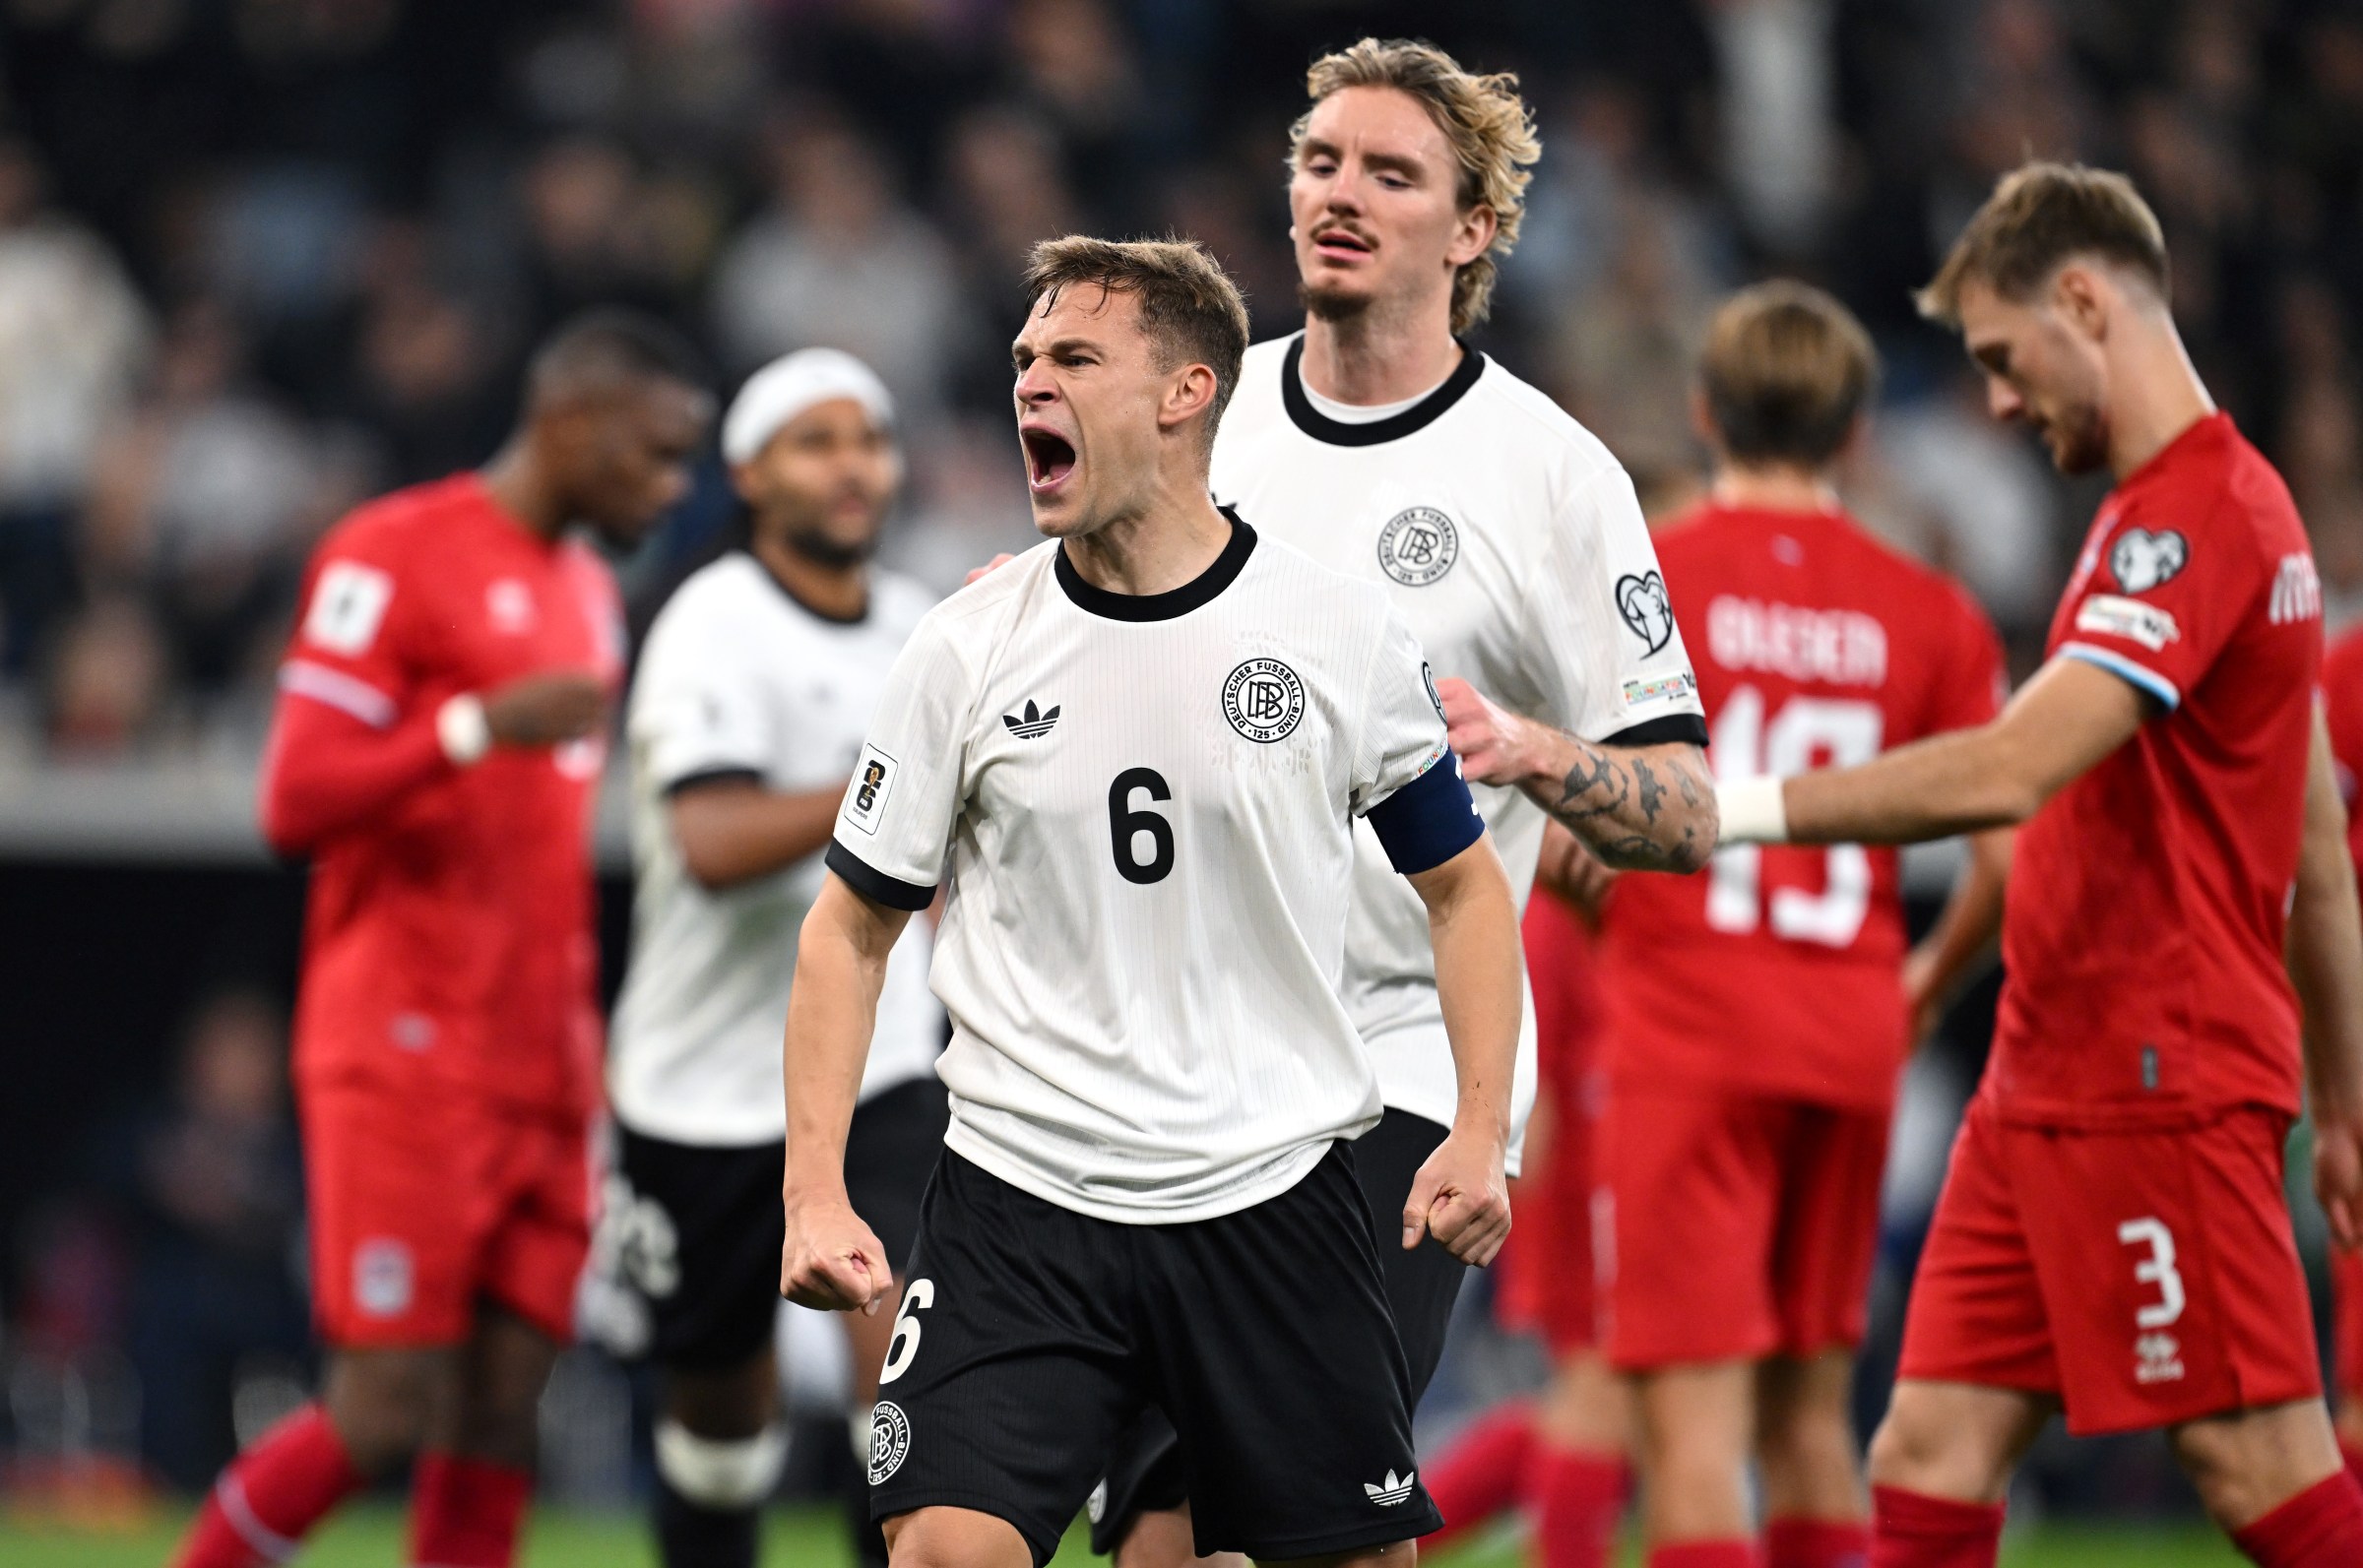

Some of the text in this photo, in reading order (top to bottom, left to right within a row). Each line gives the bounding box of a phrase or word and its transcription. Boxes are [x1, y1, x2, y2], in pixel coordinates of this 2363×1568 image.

[1227, 665, 1253, 729] DEUTSCHER
[1252, 728, 1270, 739] 125
[1108, 767, 1176, 885] 6
[2118, 1218, 2187, 1328] 3
[878, 1278, 934, 1385] 6
